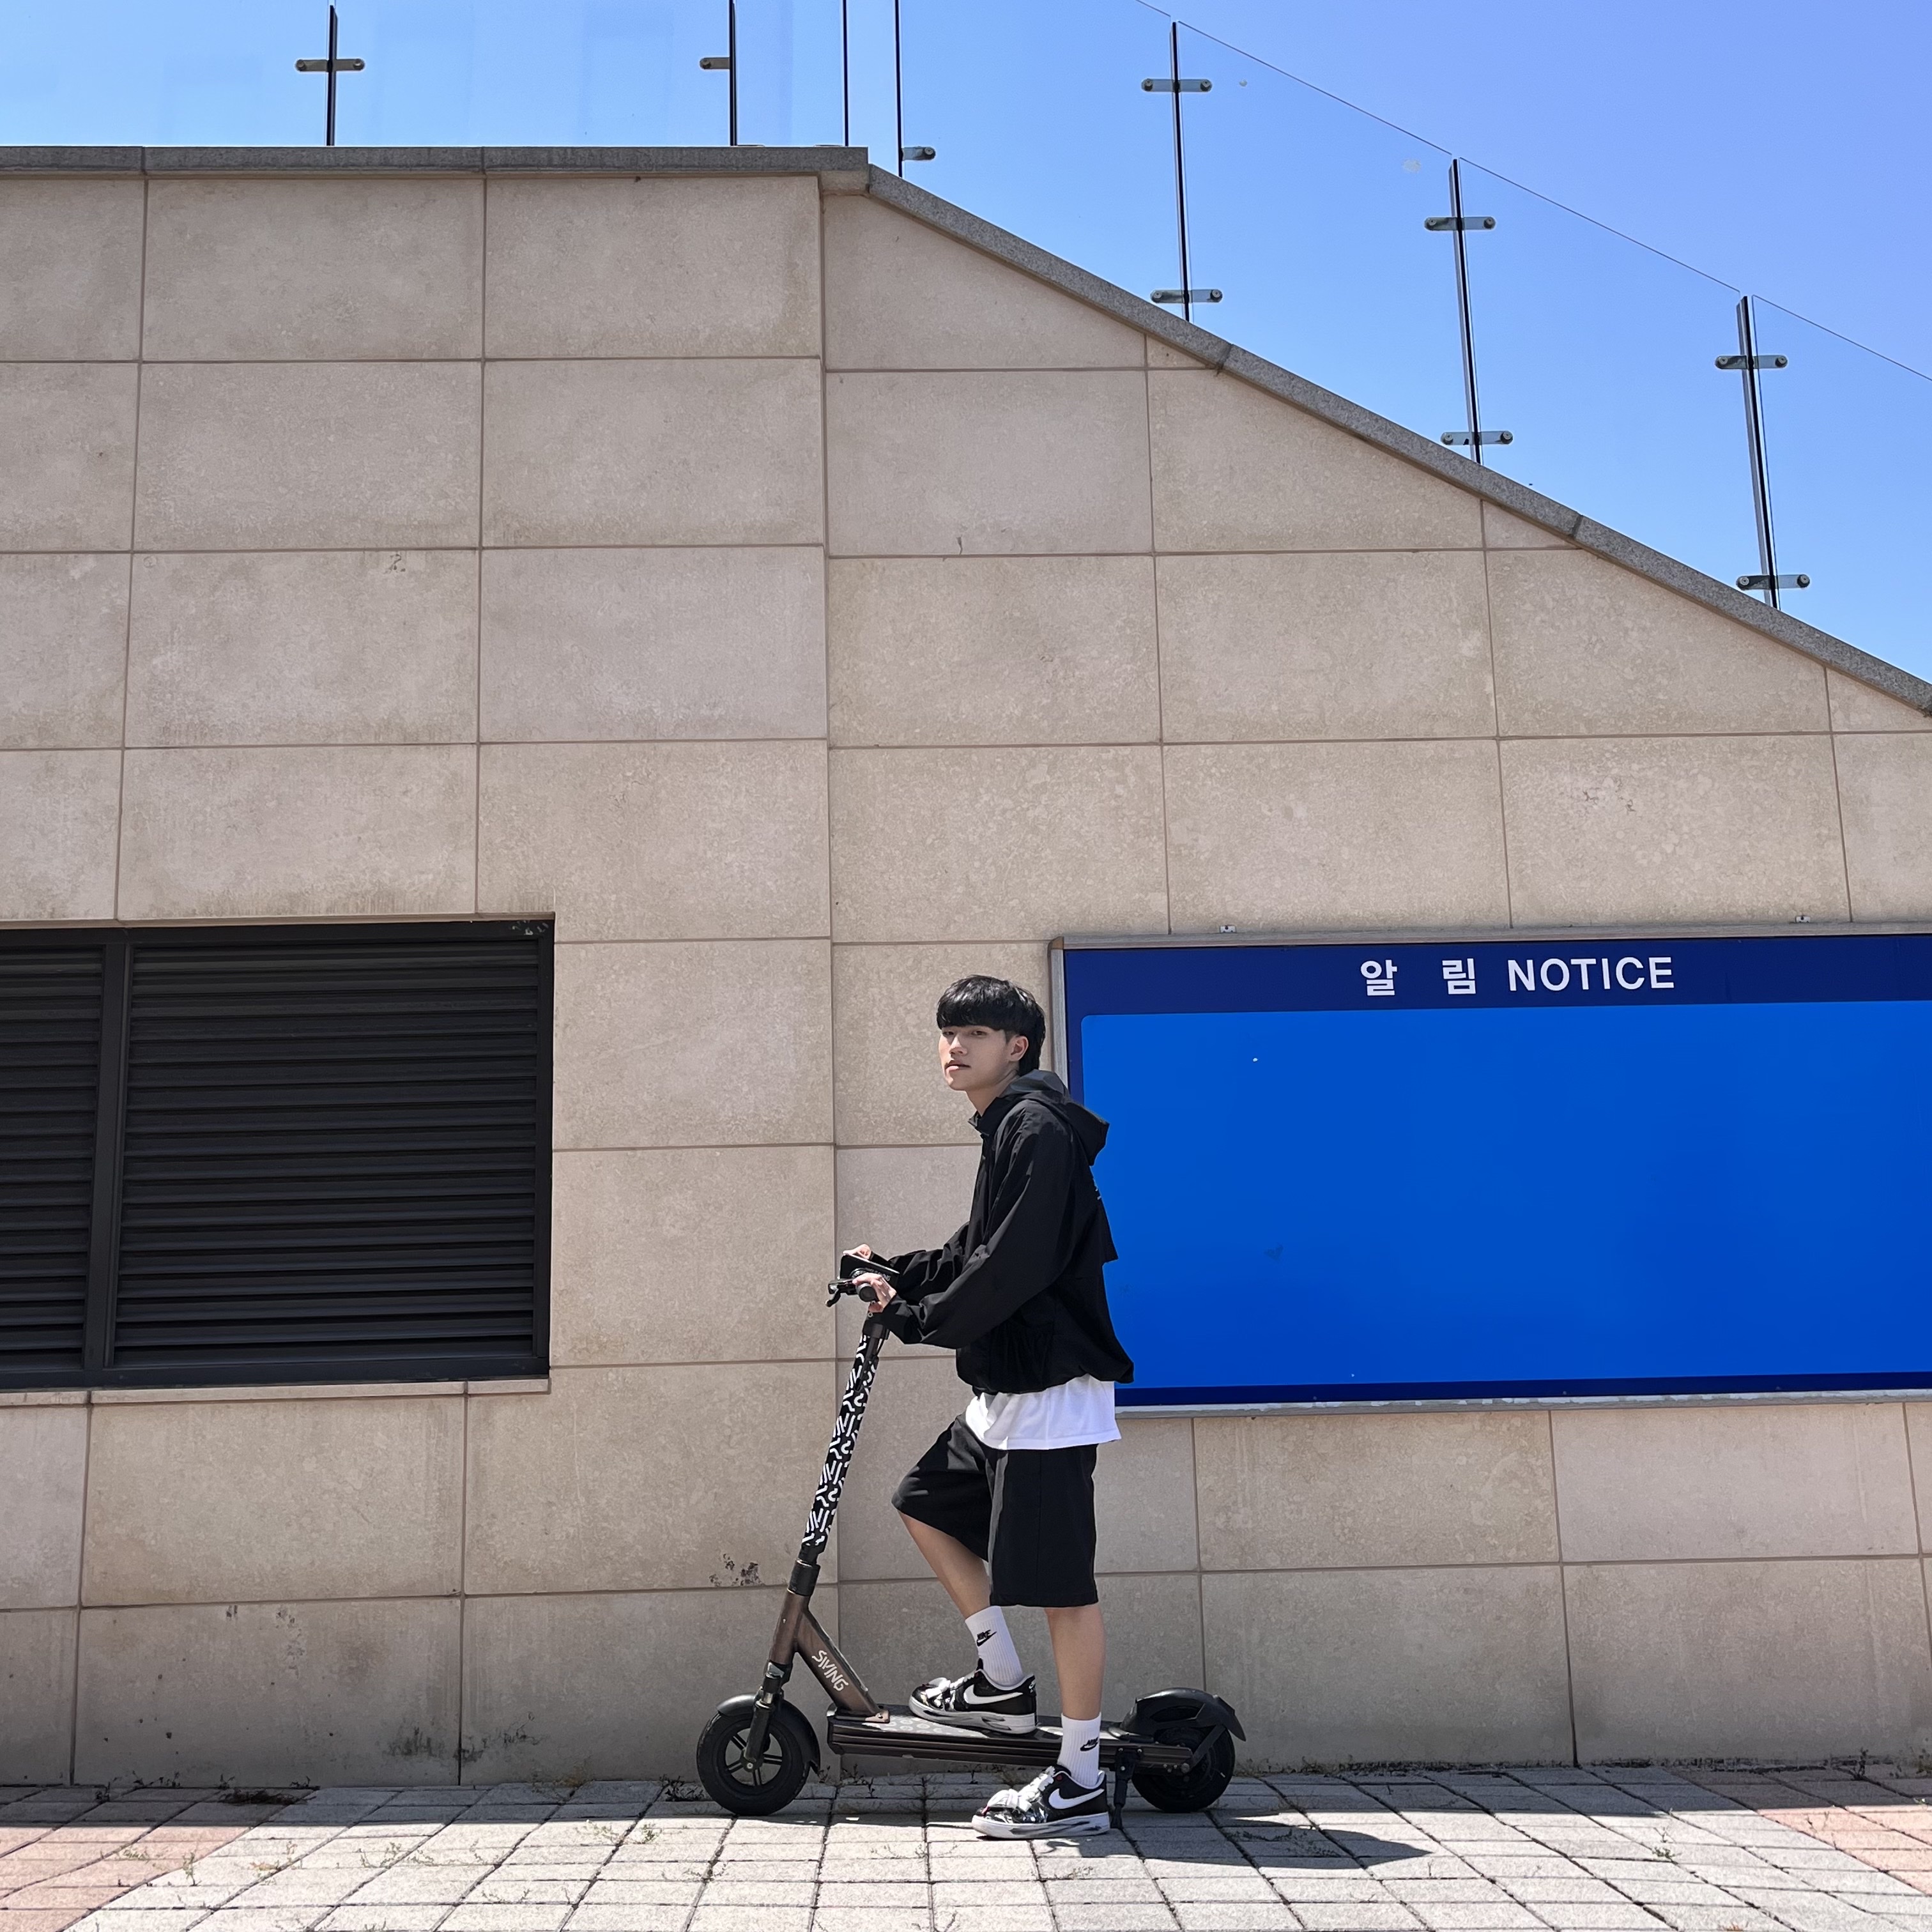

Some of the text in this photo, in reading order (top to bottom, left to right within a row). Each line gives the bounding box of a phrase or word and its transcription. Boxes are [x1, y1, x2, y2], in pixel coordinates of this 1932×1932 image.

[1360, 956, 1675, 996] 알 림 NOTICE
[811, 1650, 848, 1691] SWING
